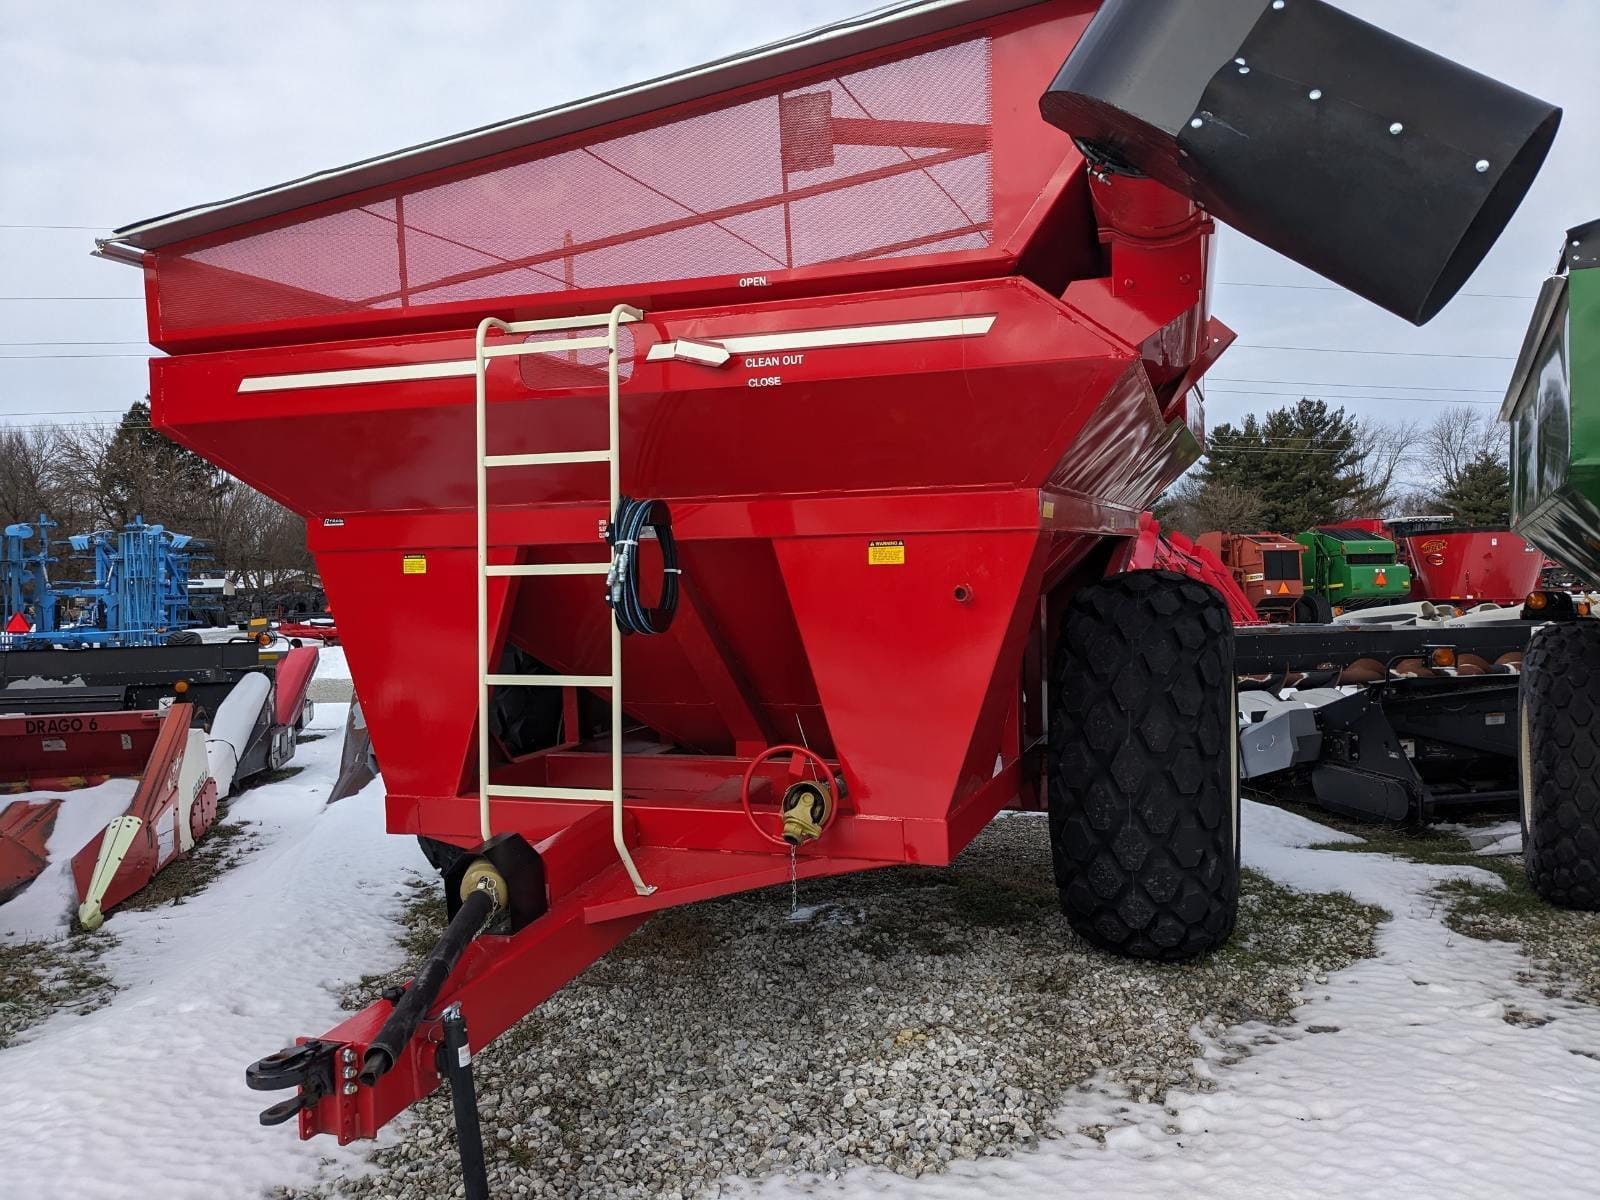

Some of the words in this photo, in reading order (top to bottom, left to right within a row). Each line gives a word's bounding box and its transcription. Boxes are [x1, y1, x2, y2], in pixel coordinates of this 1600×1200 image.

[739, 275, 767, 288] OPEN
[745, 356, 780, 368] CLEAN
[782, 354, 804, 366] OUT
[748, 376, 782, 388] CLOSE
[25, 718, 83, 734] DRAGO
[88, 717, 98, 731] 6
